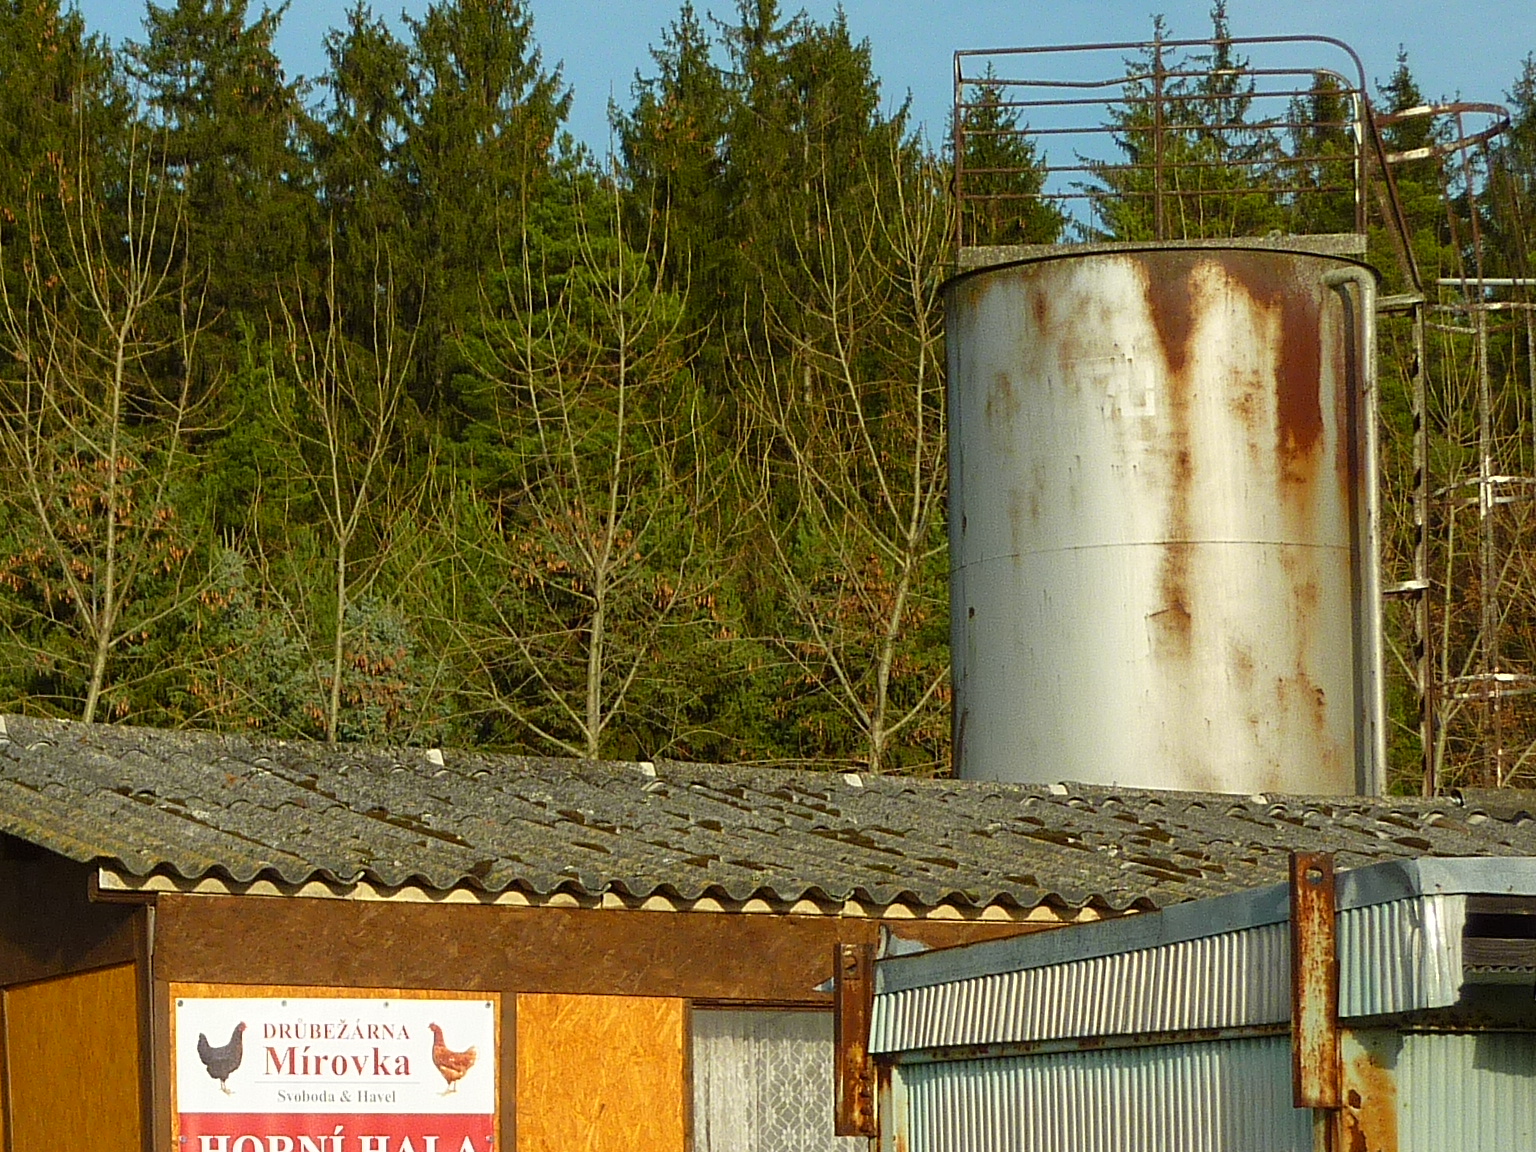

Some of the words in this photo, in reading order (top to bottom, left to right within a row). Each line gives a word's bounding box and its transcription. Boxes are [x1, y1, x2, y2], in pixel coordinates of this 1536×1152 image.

[263, 1018, 411, 1040] DRŮBEŽÁRNA
[264, 1046, 411, 1076] Mírovka
[277, 1089, 335, 1103] Svoboda
[340, 1090, 352, 1103] &
[358, 1090, 396, 1103] Havel
